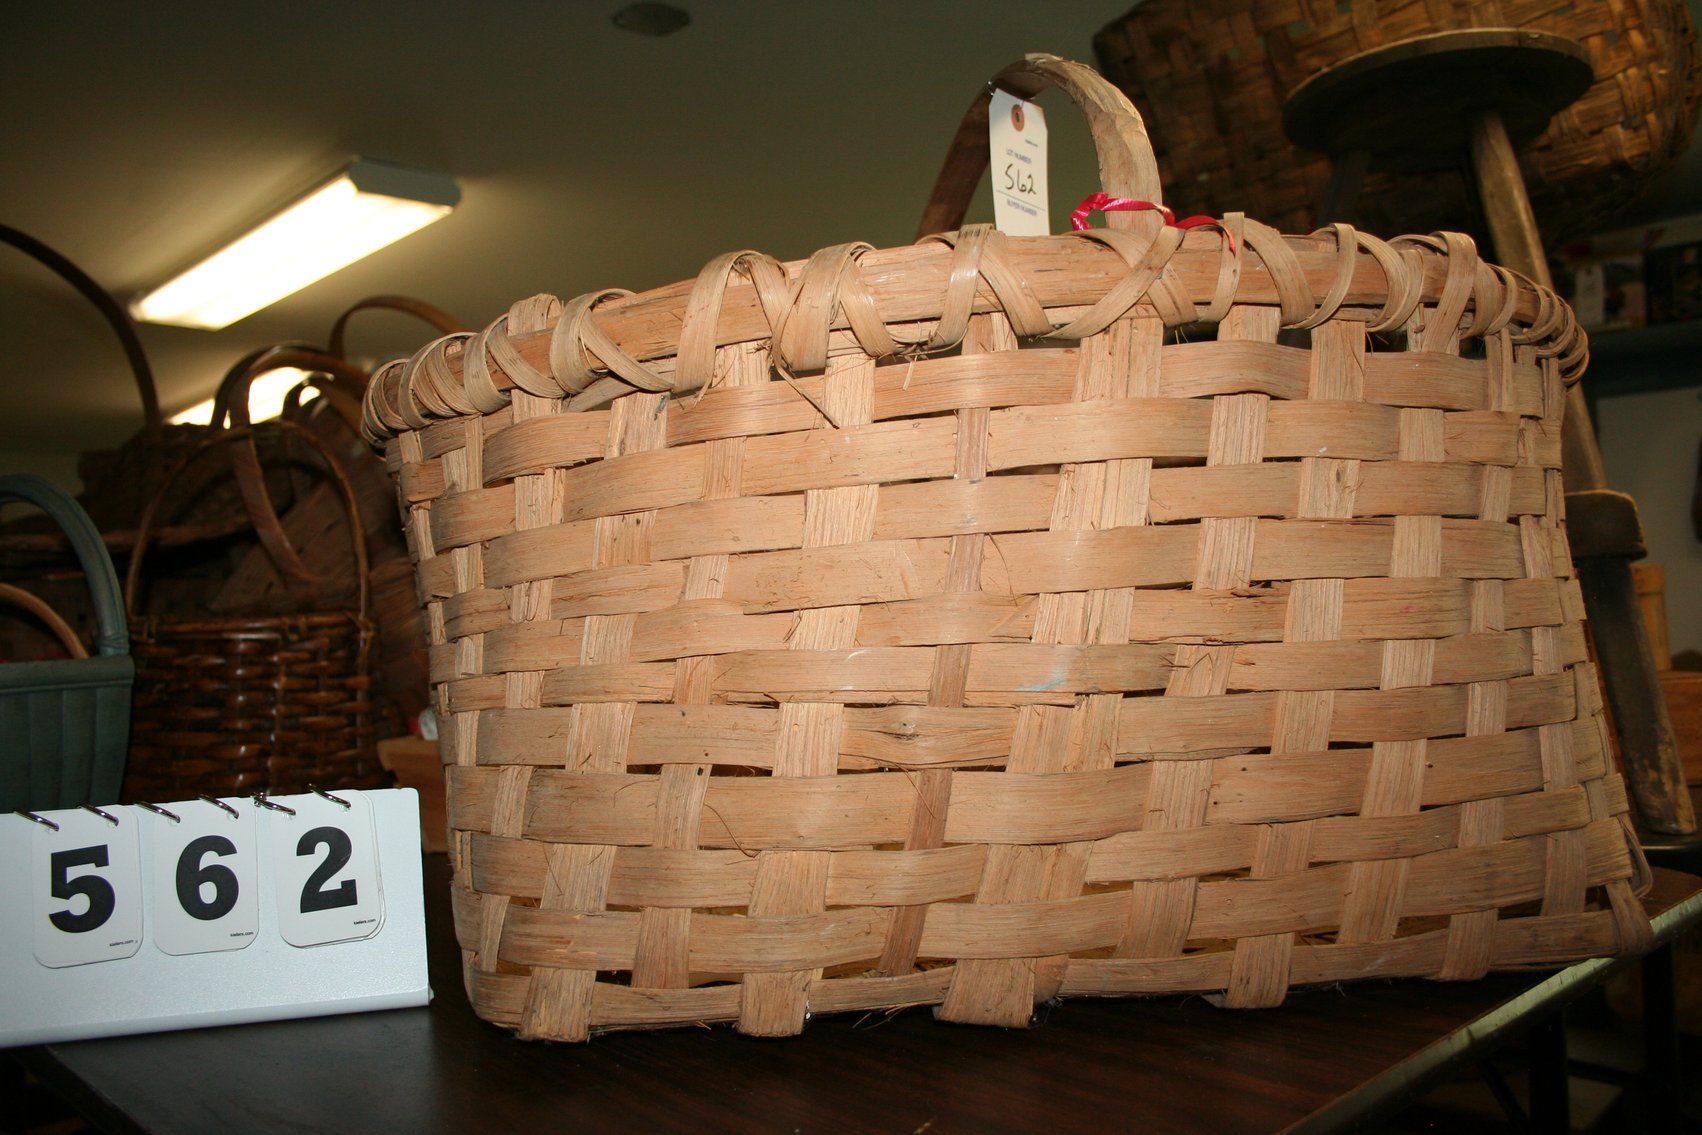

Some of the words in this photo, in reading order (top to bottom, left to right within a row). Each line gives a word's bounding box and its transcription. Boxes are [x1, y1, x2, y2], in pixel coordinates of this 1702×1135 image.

[1004, 163, 1037, 195] 562
[48, 844, 116, 933] 5
[175, 834, 239, 920] 6
[296, 826, 358, 913] 2
